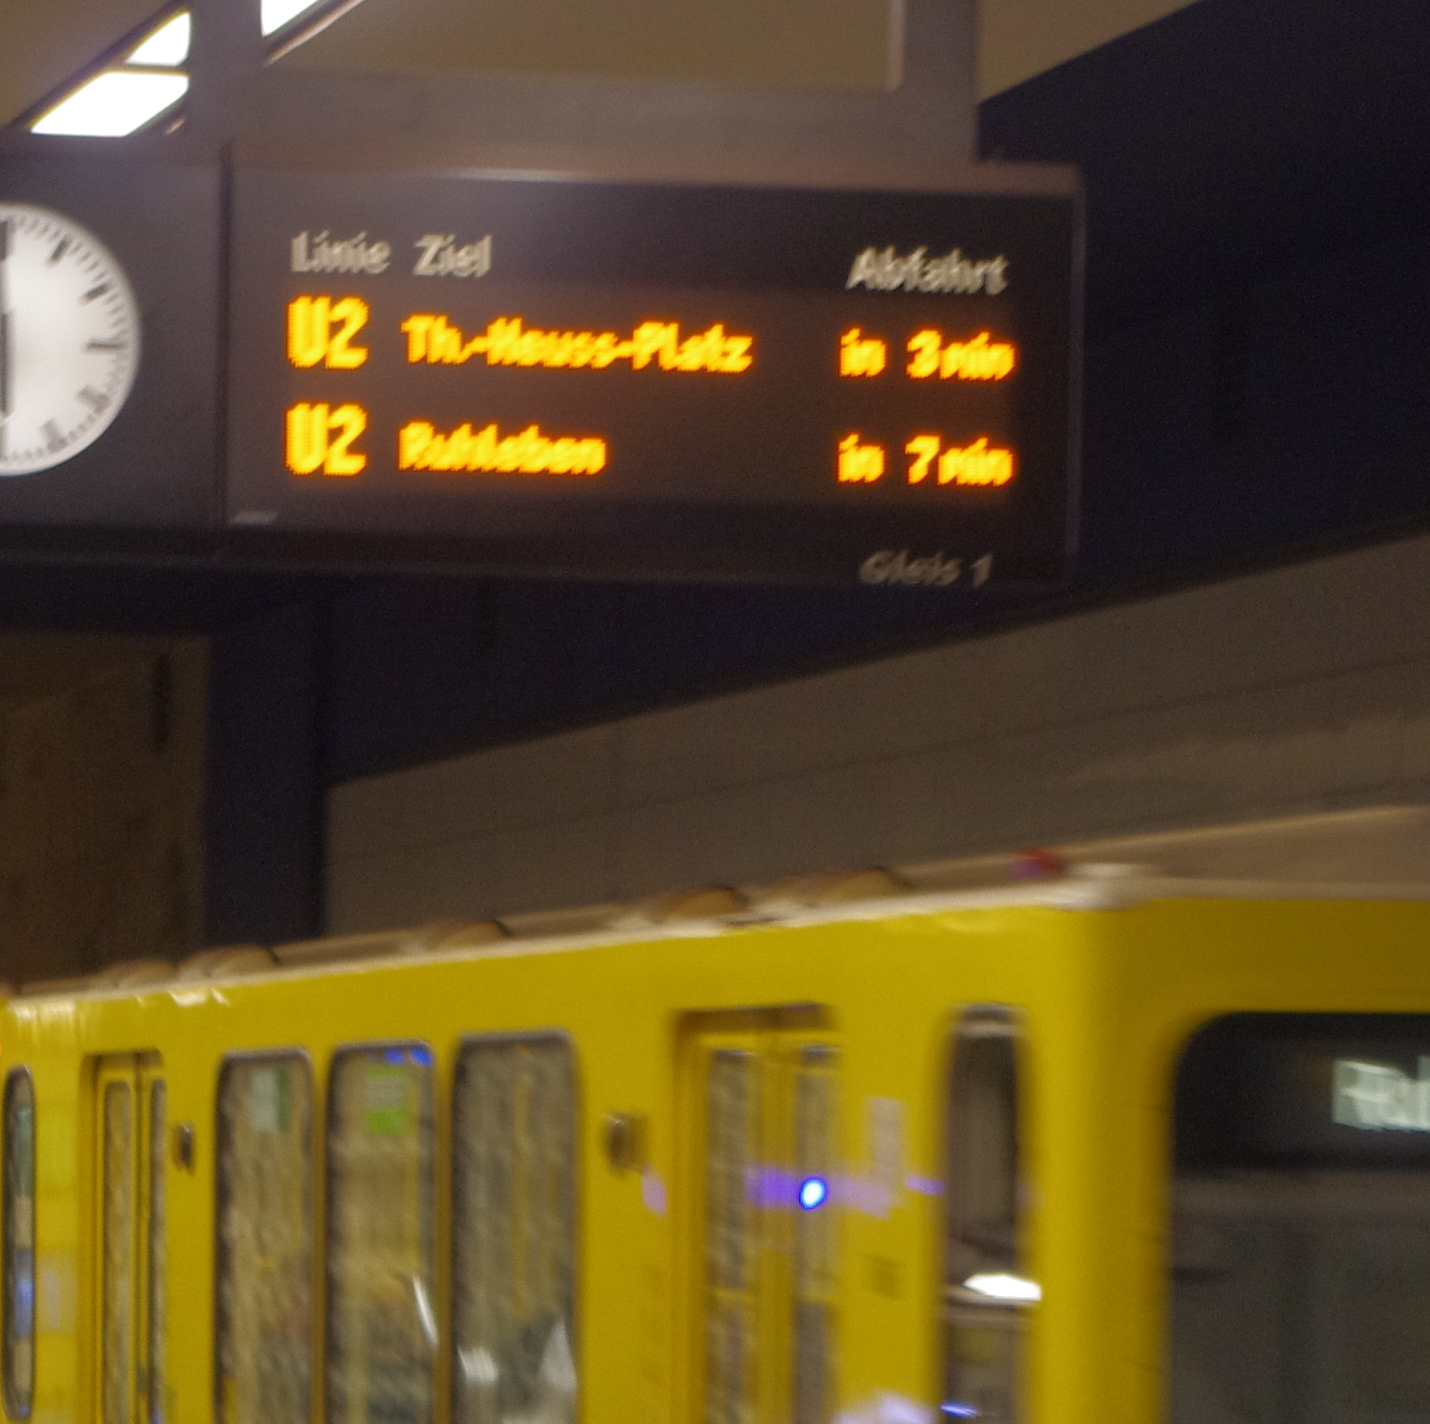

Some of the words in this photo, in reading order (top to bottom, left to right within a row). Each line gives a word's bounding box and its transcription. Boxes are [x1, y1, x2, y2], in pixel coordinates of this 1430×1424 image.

[291, 231, 391, 274] Linie
[414, 234, 492, 276] Ziel
[846, 246, 1008, 295] Abfahrt
[287, 296, 368, 368] U2
[839, 328, 887, 377] in
[286, 403, 367, 475] U2
[399, 421, 607, 475] Ruhleben
[837, 433, 885, 482] in
[859, 550, 961, 586] Gleis
[971, 552, 994, 587] 1
